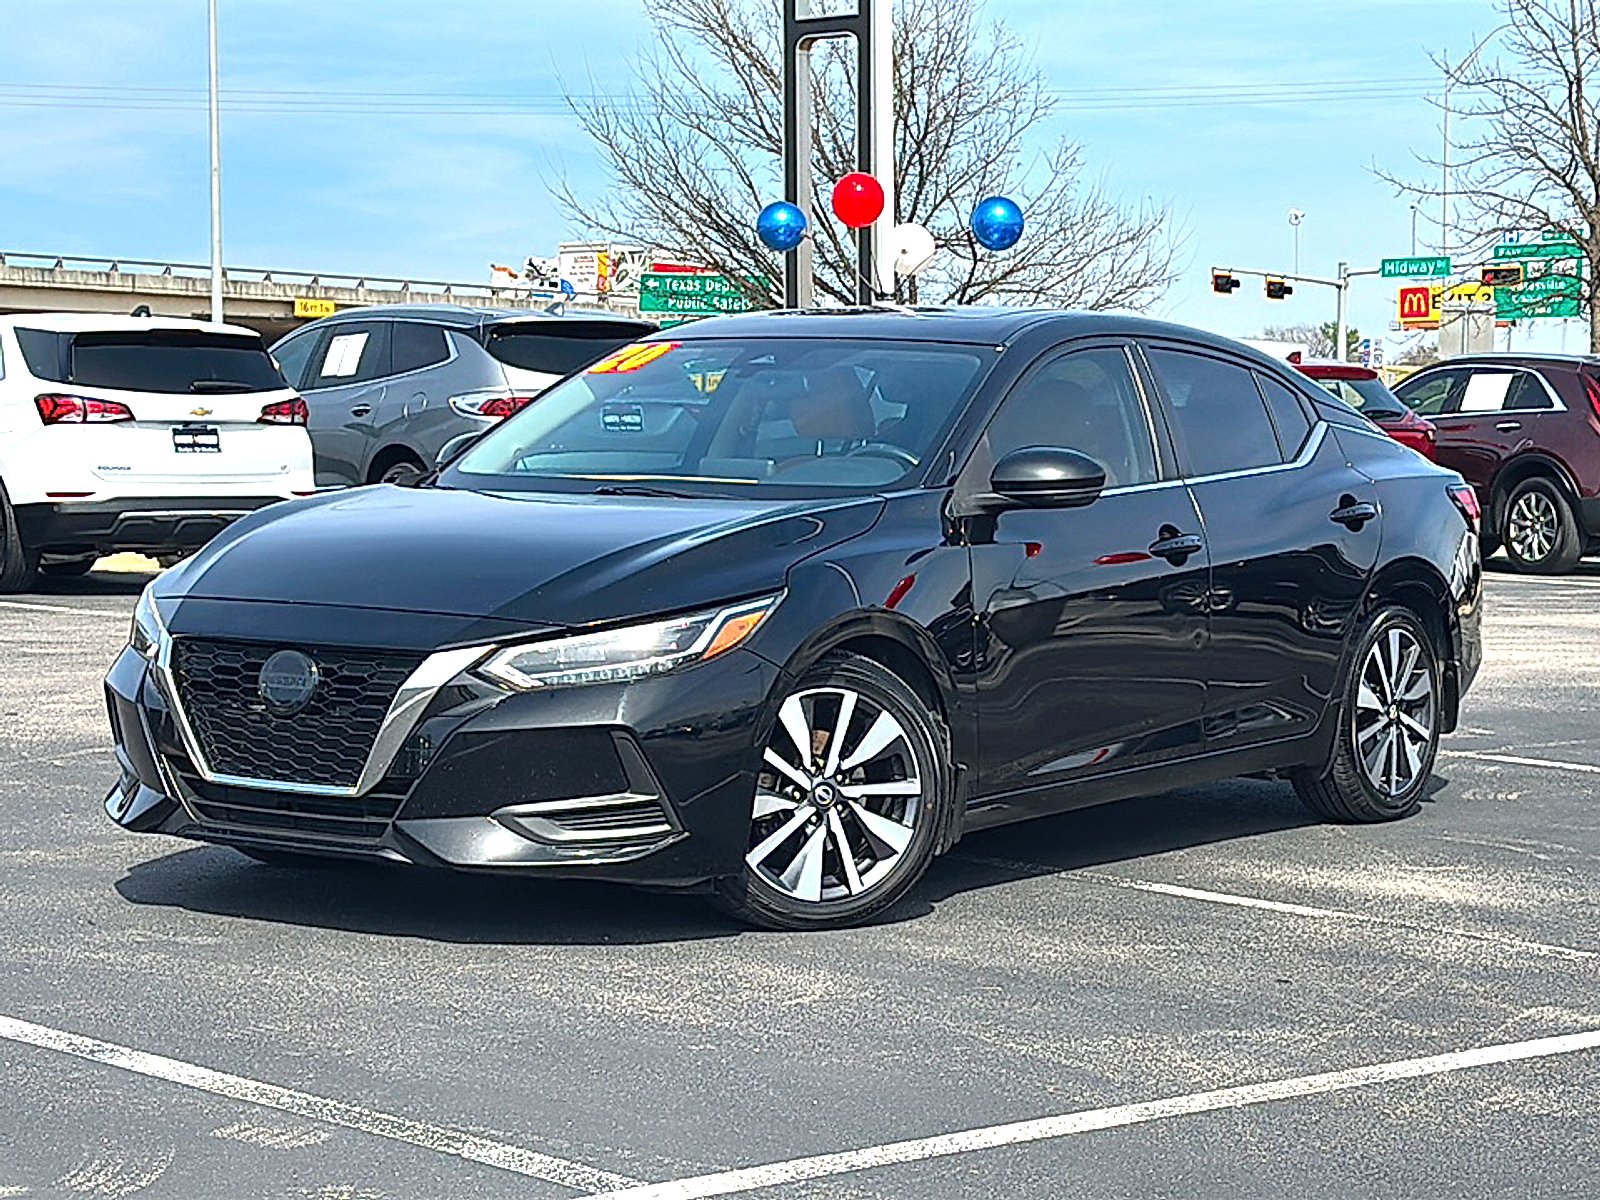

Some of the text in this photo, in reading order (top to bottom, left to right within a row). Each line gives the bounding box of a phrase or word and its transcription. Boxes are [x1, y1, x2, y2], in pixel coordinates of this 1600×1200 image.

[1384, 260, 1435, 276] Midway
[664, 278, 701, 292] Texas
[667, 296, 753, 311] Public Safety
